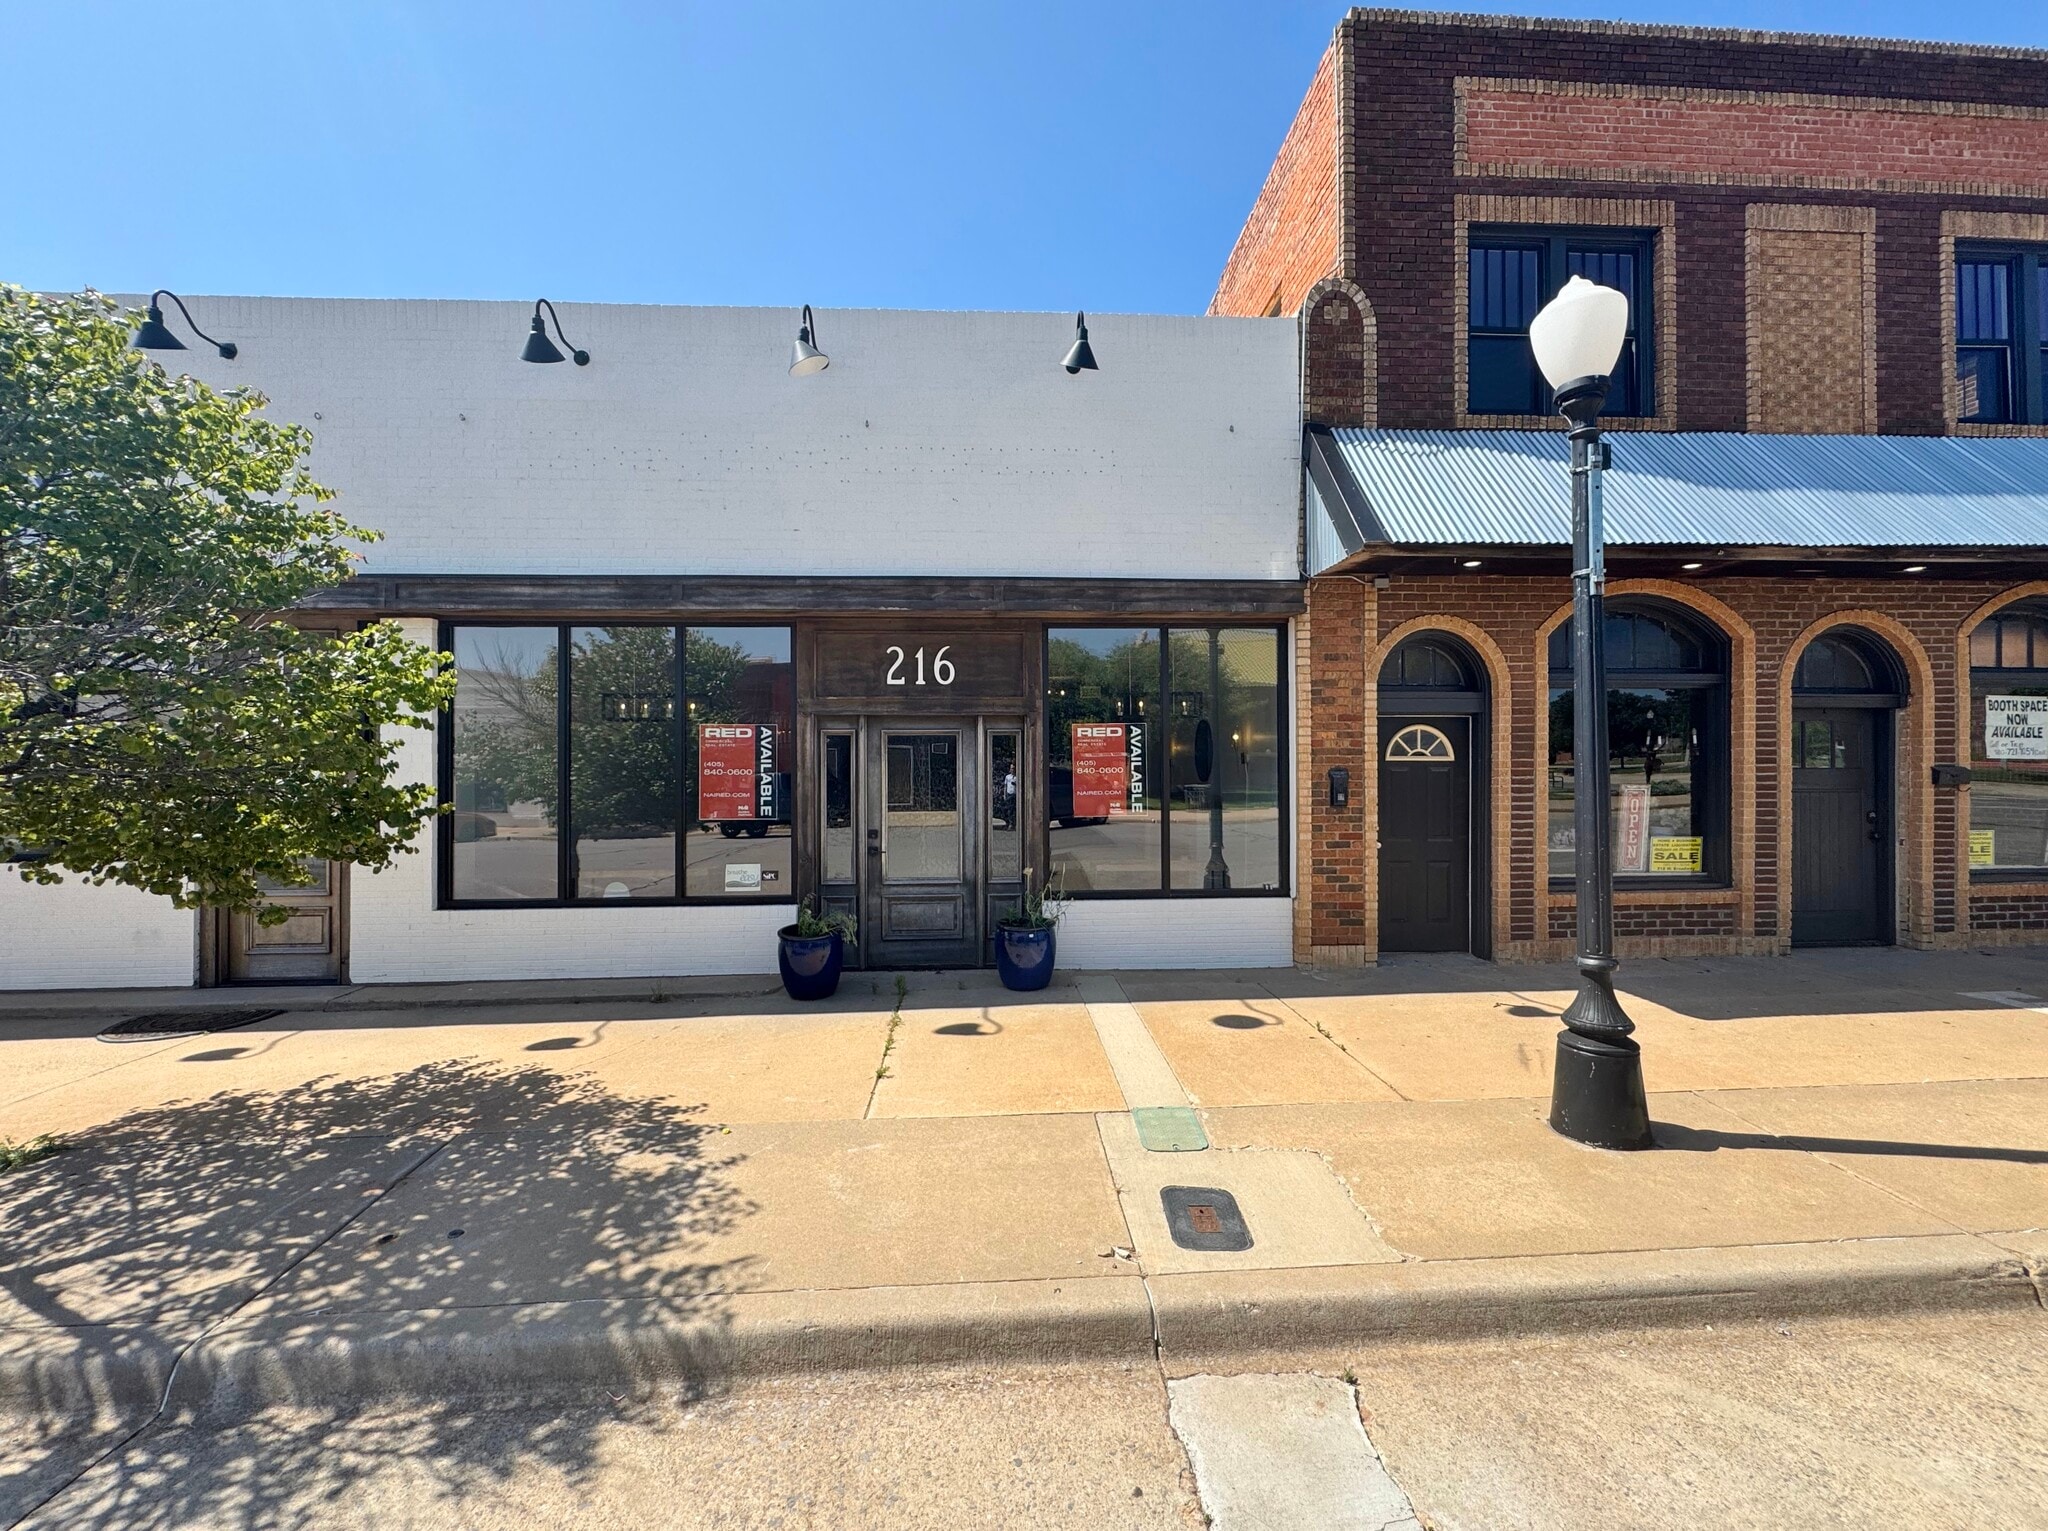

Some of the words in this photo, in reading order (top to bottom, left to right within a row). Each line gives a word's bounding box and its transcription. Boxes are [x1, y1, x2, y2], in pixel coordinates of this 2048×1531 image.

[886, 645, 956, 686] 216
[1988, 699, 2018, 711] BOOTH
[2020, 700, 2048, 712] SPACE
[2007, 713, 2028, 725] NOW
[704, 727, 753, 738] RED
[1076, 727, 1123, 737] RED
[1991, 726, 2043, 739] AVAILABLE
[703, 768, 753, 776] 840-0600
[760, 726, 772, 817] AVAILABLE
[1130, 725, 1143, 813] AVAILABLE
[1626, 798, 1641, 859] OPEN
[1654, 851, 1699, 861] SALE
